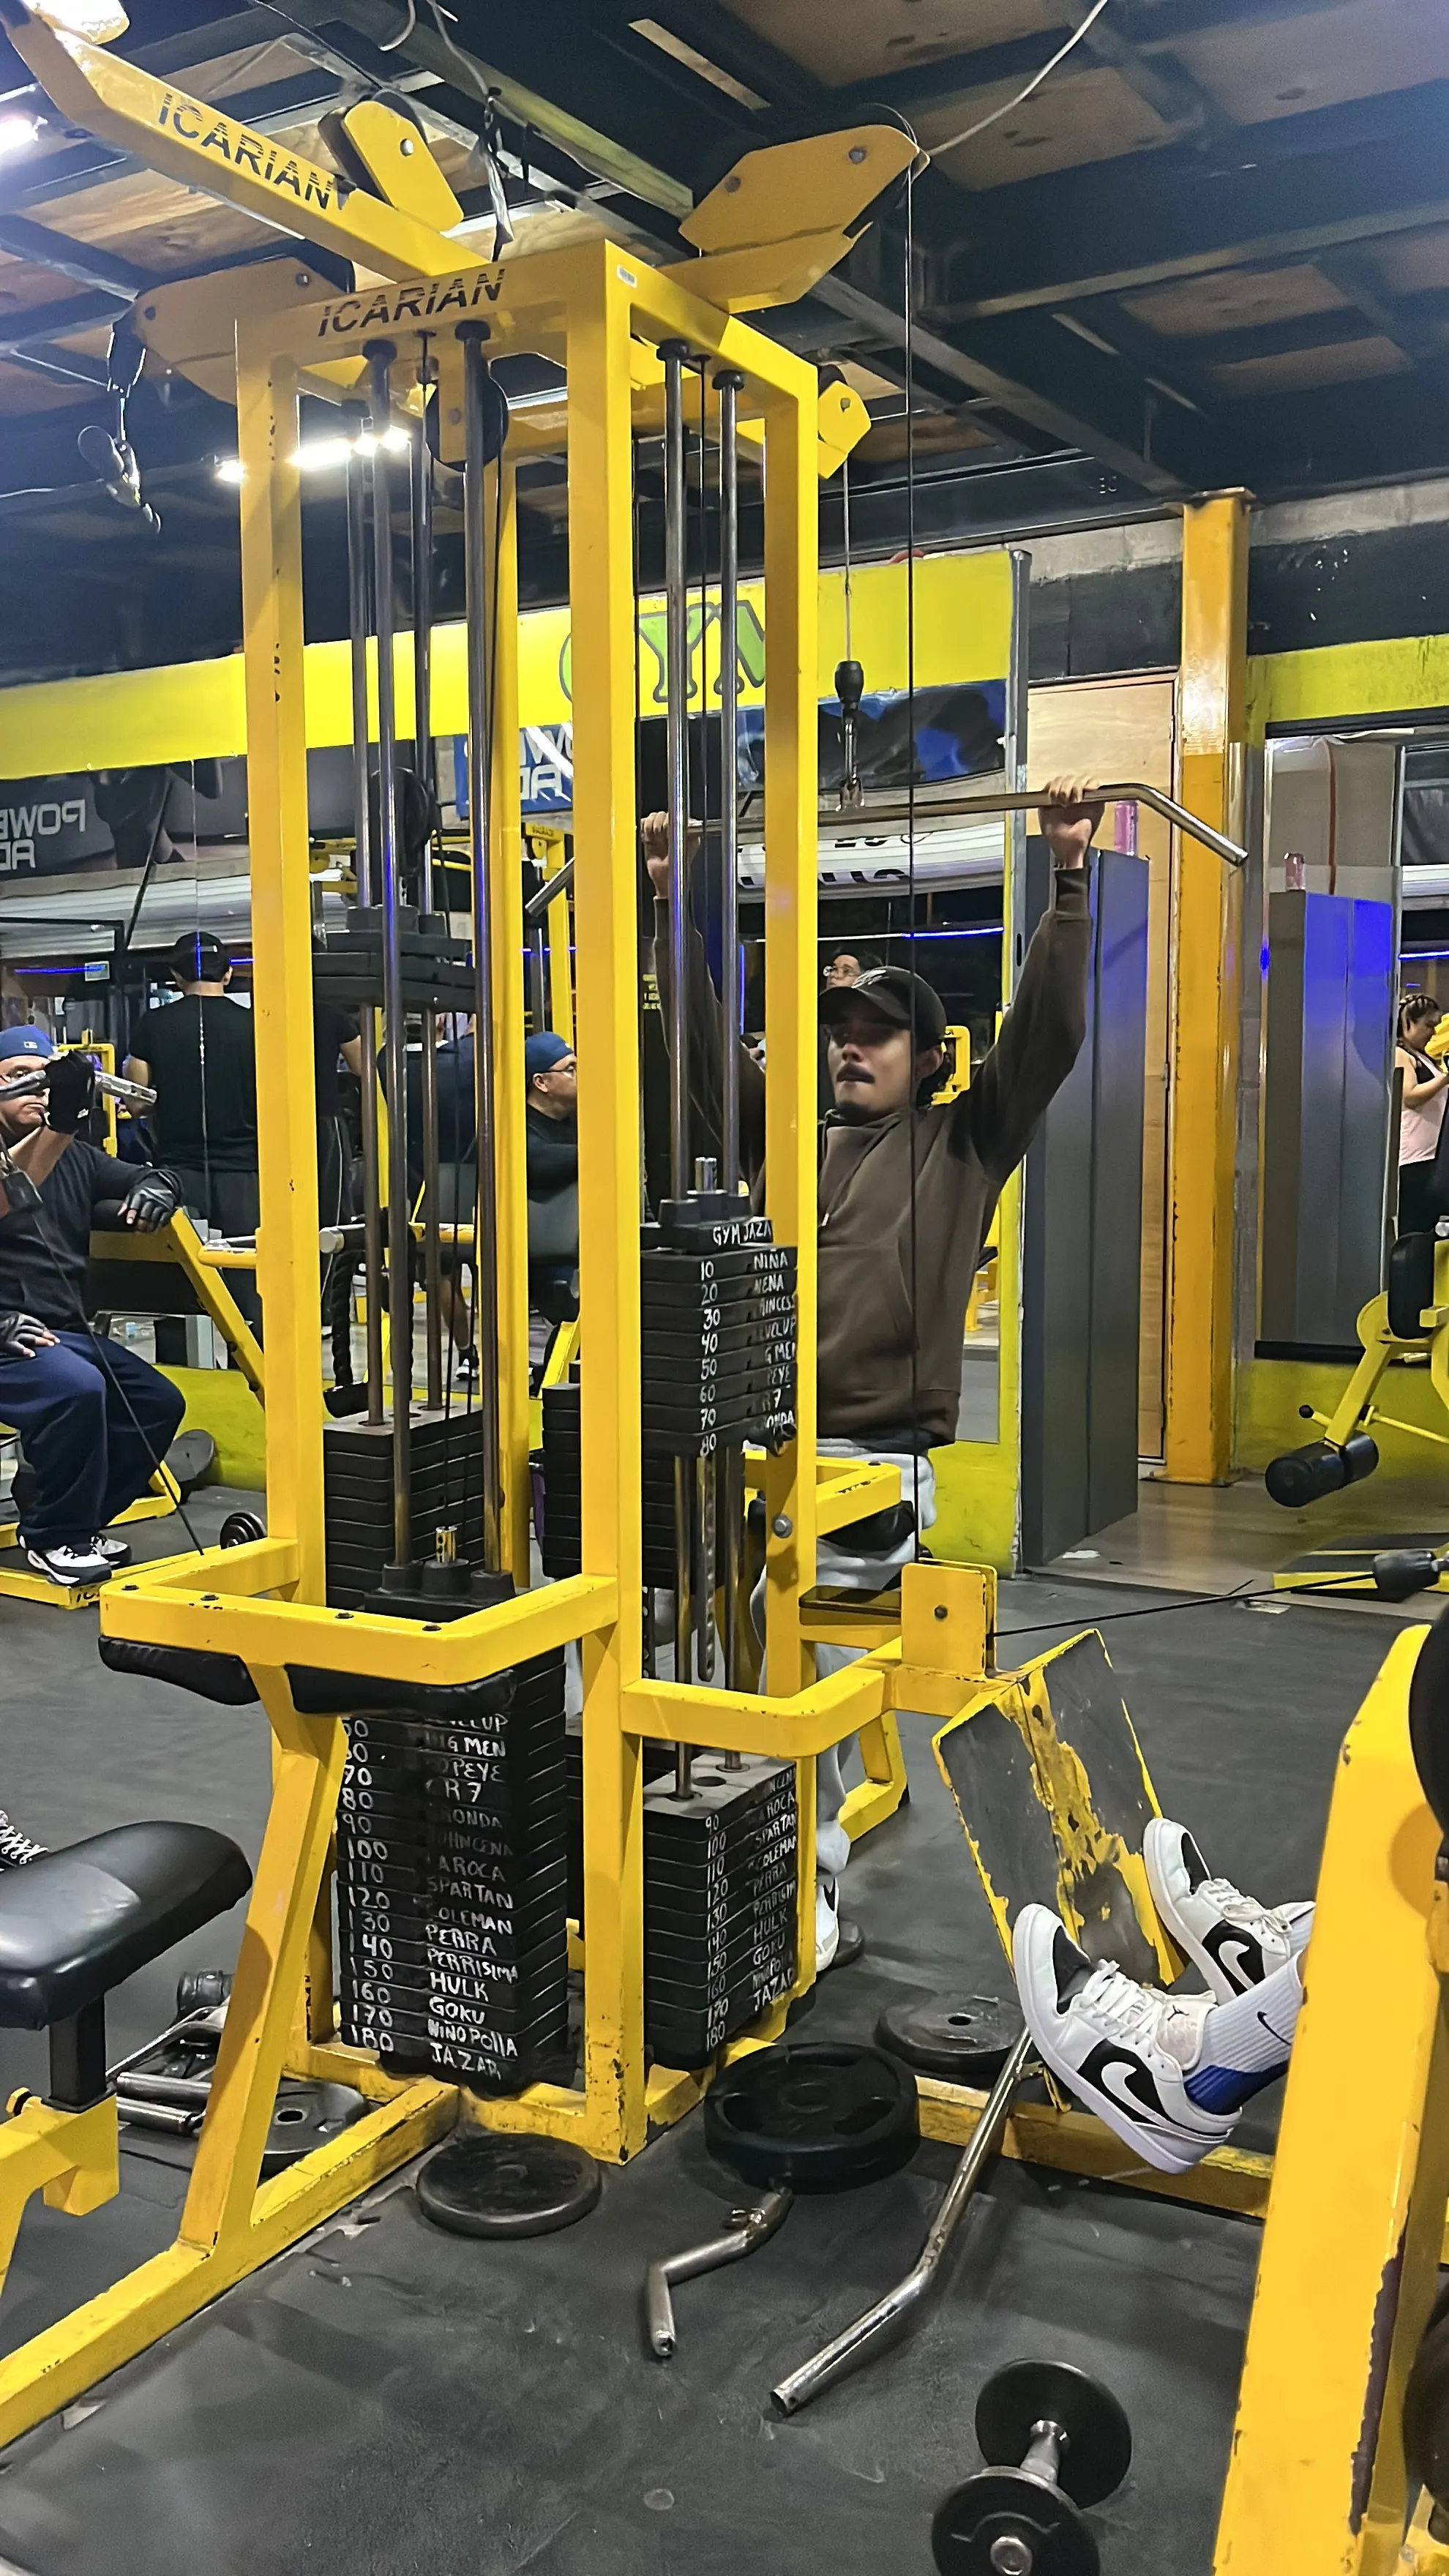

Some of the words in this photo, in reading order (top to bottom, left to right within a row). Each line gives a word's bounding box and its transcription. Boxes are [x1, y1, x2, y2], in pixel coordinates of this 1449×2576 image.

[159, 92, 333, 210] ICARIAN
[318, 268, 506, 337] ICARIAN
[713, 1224, 741, 1246] GYM
[700, 1260, 714, 1281] 10
[701, 1283, 718, 1306] 20
[754, 1274, 785, 1294] NENA
[703, 1308, 721, 1330] 30
[701, 1332, 718, 1355] 40
[700, 1358, 717, 1381] 50
[700, 1384, 716, 1404] 60
[700, 1408, 716, 1431] 70
[700, 1433, 716, 1458] 80
[464, 1737, 506, 1757] MEN
[344, 1764, 373, 1786] 70
[342, 1787, 375, 1811] 80
[342, 1813, 372, 1835] 90
[705, 1814, 719, 1836] 90
[348, 1837, 389, 1861] 100
[706, 1830, 727, 1860] 100
[348, 1861, 384, 1884] 110
[707, 1855, 725, 1885] 110
[348, 1886, 391, 1910] 120
[427, 1876, 513, 1909] SPARTAN
[707, 1878, 729, 1909] 120
[348, 1908, 390, 1933] 130
[707, 1903, 727, 1933] 130
[349, 1933, 393, 1960] 140
[425, 1923, 498, 1956] PERRA
[707, 1928, 727, 1956] 140
[707, 1951, 727, 1981] 150
[754, 1907, 788, 1945] HULK
[350, 1955, 393, 1980] 150
[707, 1973, 726, 2004] 160
[753, 1931, 785, 1966] GOKU
[352, 1979, 392, 2004] 160
[430, 1972, 489, 2002] HULK
[353, 2004, 393, 2028] 170
[429, 1996, 486, 2025] GOKU
[707, 1997, 729, 2029] 170
[351, 2024, 394, 2052] 180
[705, 2021, 726, 2052] 180
[429, 2042, 501, 2081] JAZAR
